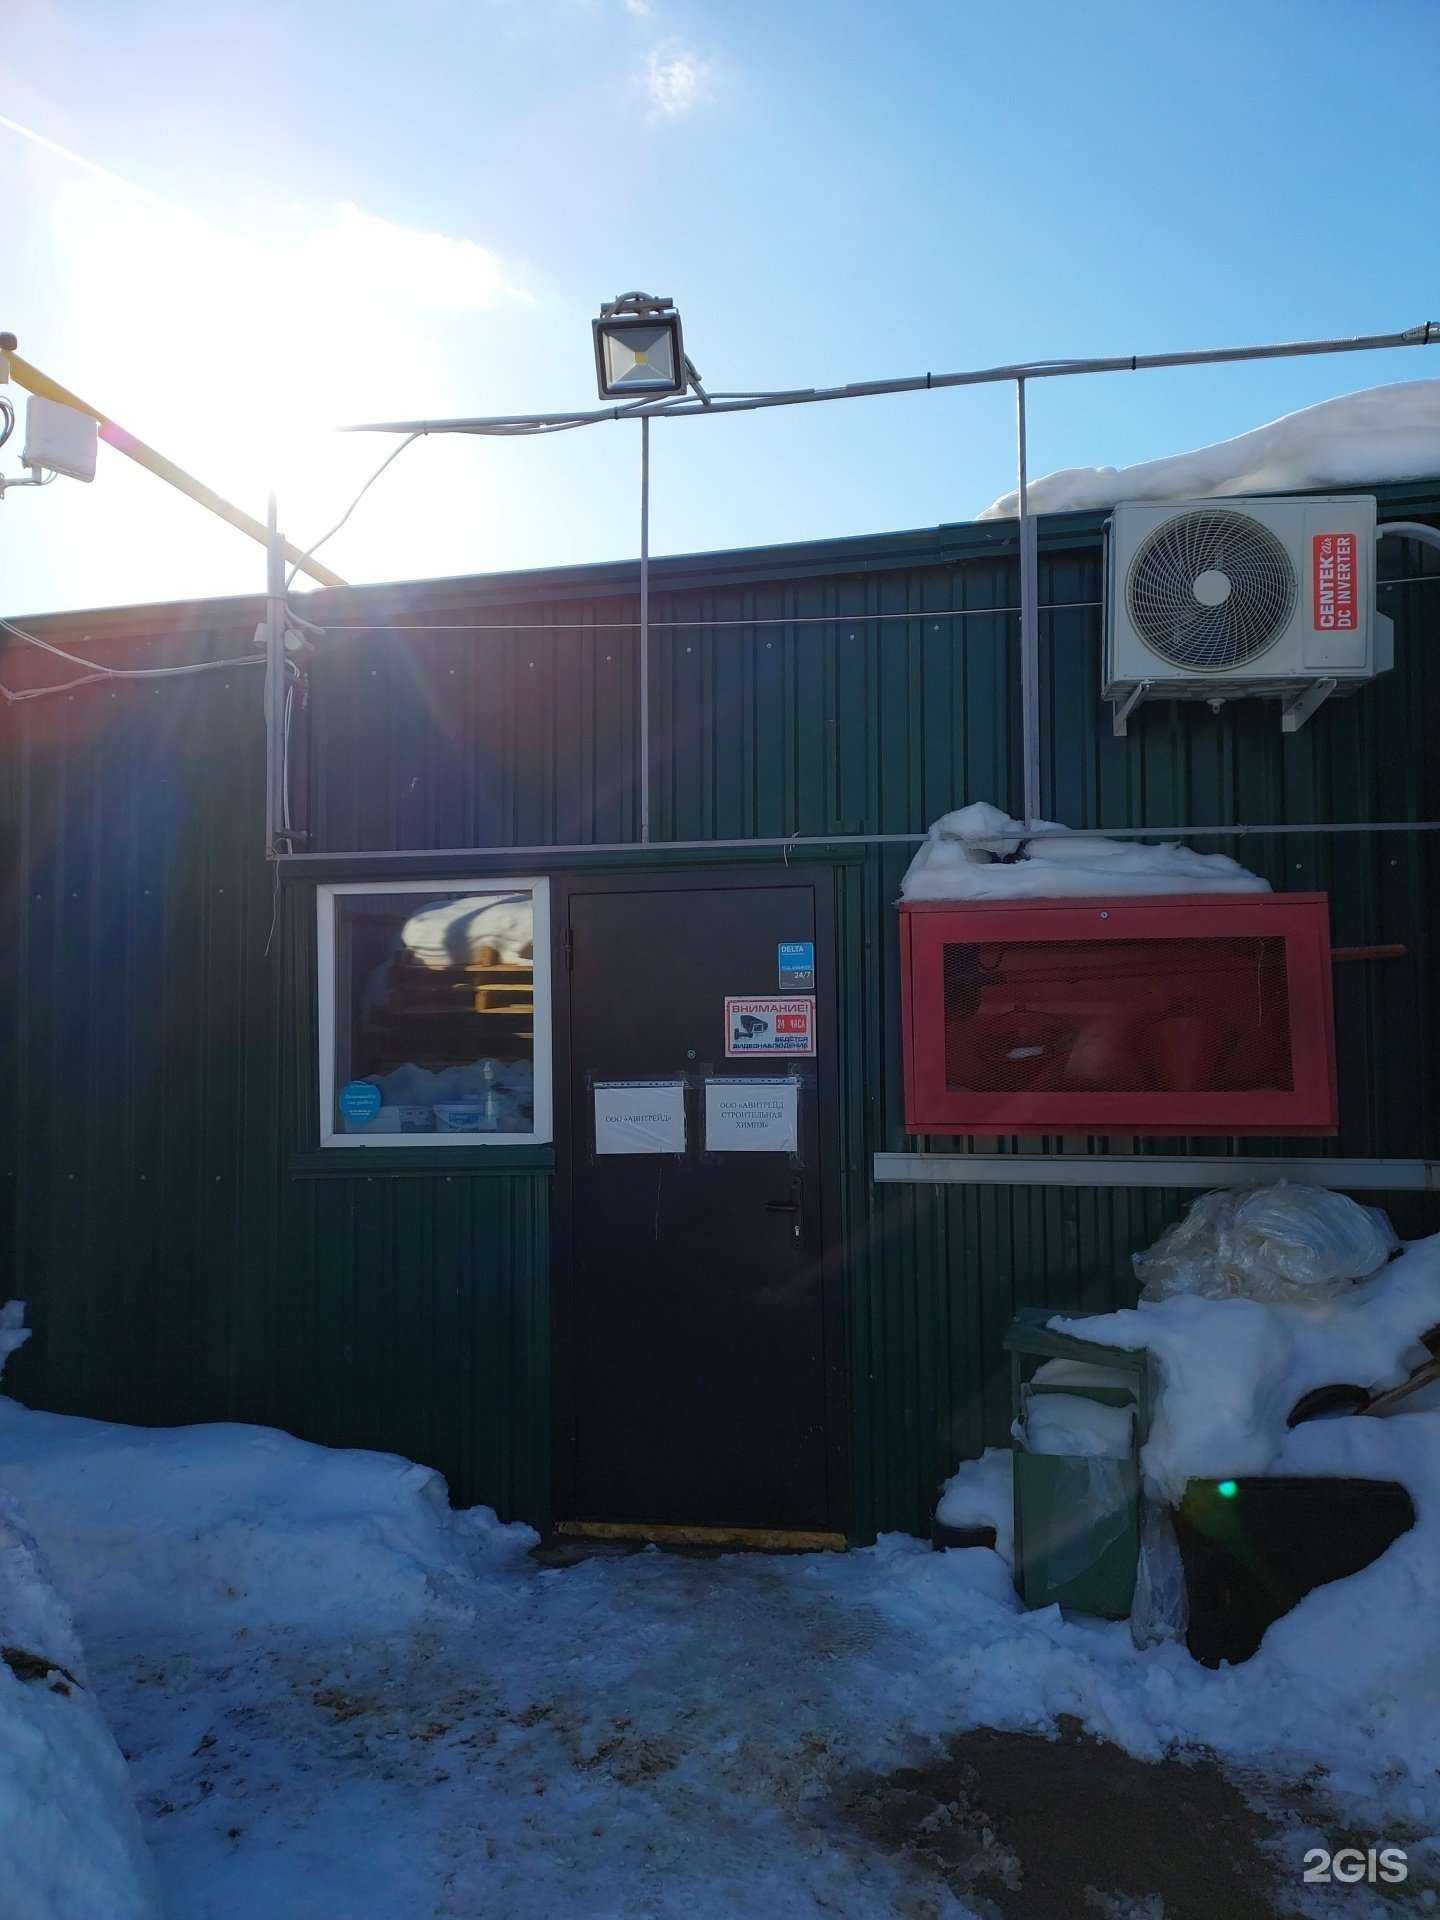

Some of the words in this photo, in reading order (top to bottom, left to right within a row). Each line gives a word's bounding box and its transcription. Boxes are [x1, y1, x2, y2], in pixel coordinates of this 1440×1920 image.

[1337, 537, 1351, 604] INVERTER
[1320, 555, 1334, 628] CENTEK
[1337, 610, 1351, 627] DC
[781, 945, 804, 953] DELTA
[732, 1004, 809, 1013] ВНИМАНИЕ!
[720, 1102, 736, 1110] ООО
[605, 1115, 623, 1123] ООО
[721, 1111, 783, 1119] СТРОИТЕЛЬНАЯ
